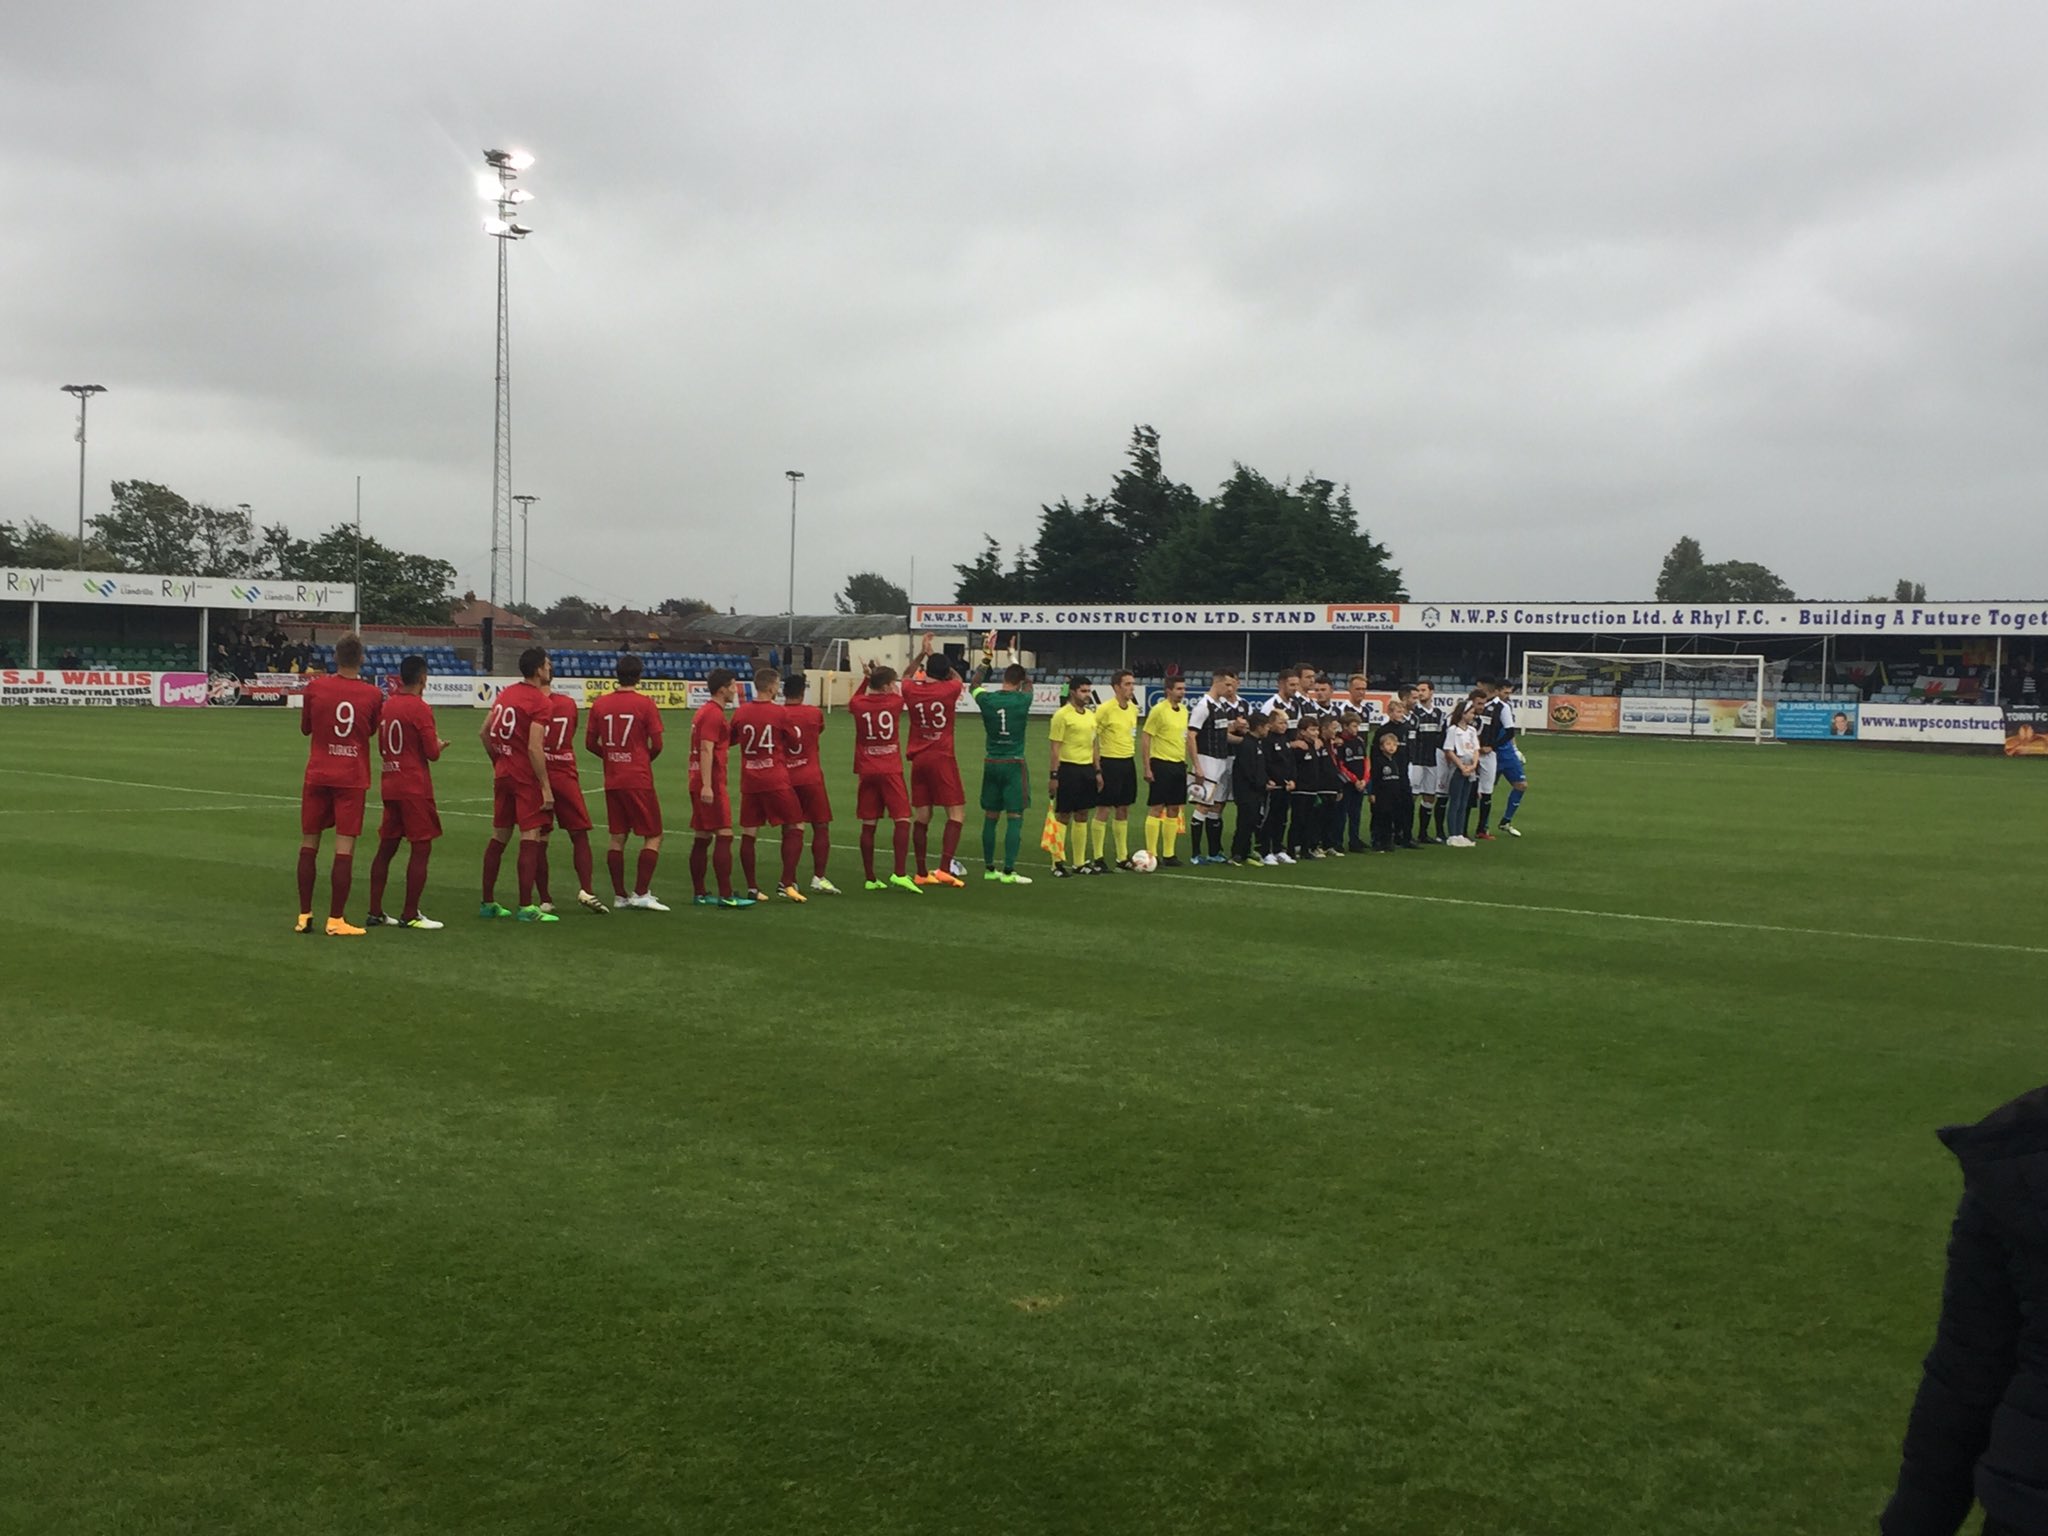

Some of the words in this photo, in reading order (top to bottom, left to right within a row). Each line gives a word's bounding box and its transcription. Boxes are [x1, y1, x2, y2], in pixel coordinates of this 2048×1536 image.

[923, 612, 966, 622] N.W.P.S.
[981, 612, 1050, 624] N.W.P.S.
[1056, 612, 1197, 624] CONSTRUCTION
[1204, 612, 1246, 624] LTD.
[1252, 612, 1316, 624] STAND
[1335, 612, 1391, 623] N.W.P.S.
[1514, 609, 1626, 625] Construction
[1633, 609, 1667, 625] Ltd.
[1672, 610, 1684, 625] &
[1690, 609, 1730, 629] Rhyl
[1736, 610, 1769, 625] F.C.
[1799, 609, 1886, 630] Building
[1893, 610, 1905, 625] A
[1911, 609, 1981, 625] Future
[3, 671, 52, 685] S.J.
[62, 671, 152, 686] WALLIS
[586, 681, 610, 691] GMC
[667, 681, 685, 691] LTD
[3, 687, 57, 695] ROOFING
[60, 686, 152, 697] CONTRACTORS
[915, 701, 947, 729] 13
[1789, 703, 1814, 711] JAMES
[334, 701, 355, 737] 9
[996, 708, 1010, 735] 1
[1862, 715, 2006, 732] www.nwpsconstruct
[2035, 712, 2048, 721] FC
[603, 714, 635, 747] 17
[862, 711, 894, 741] 19
[743, 723, 775, 755] 24
